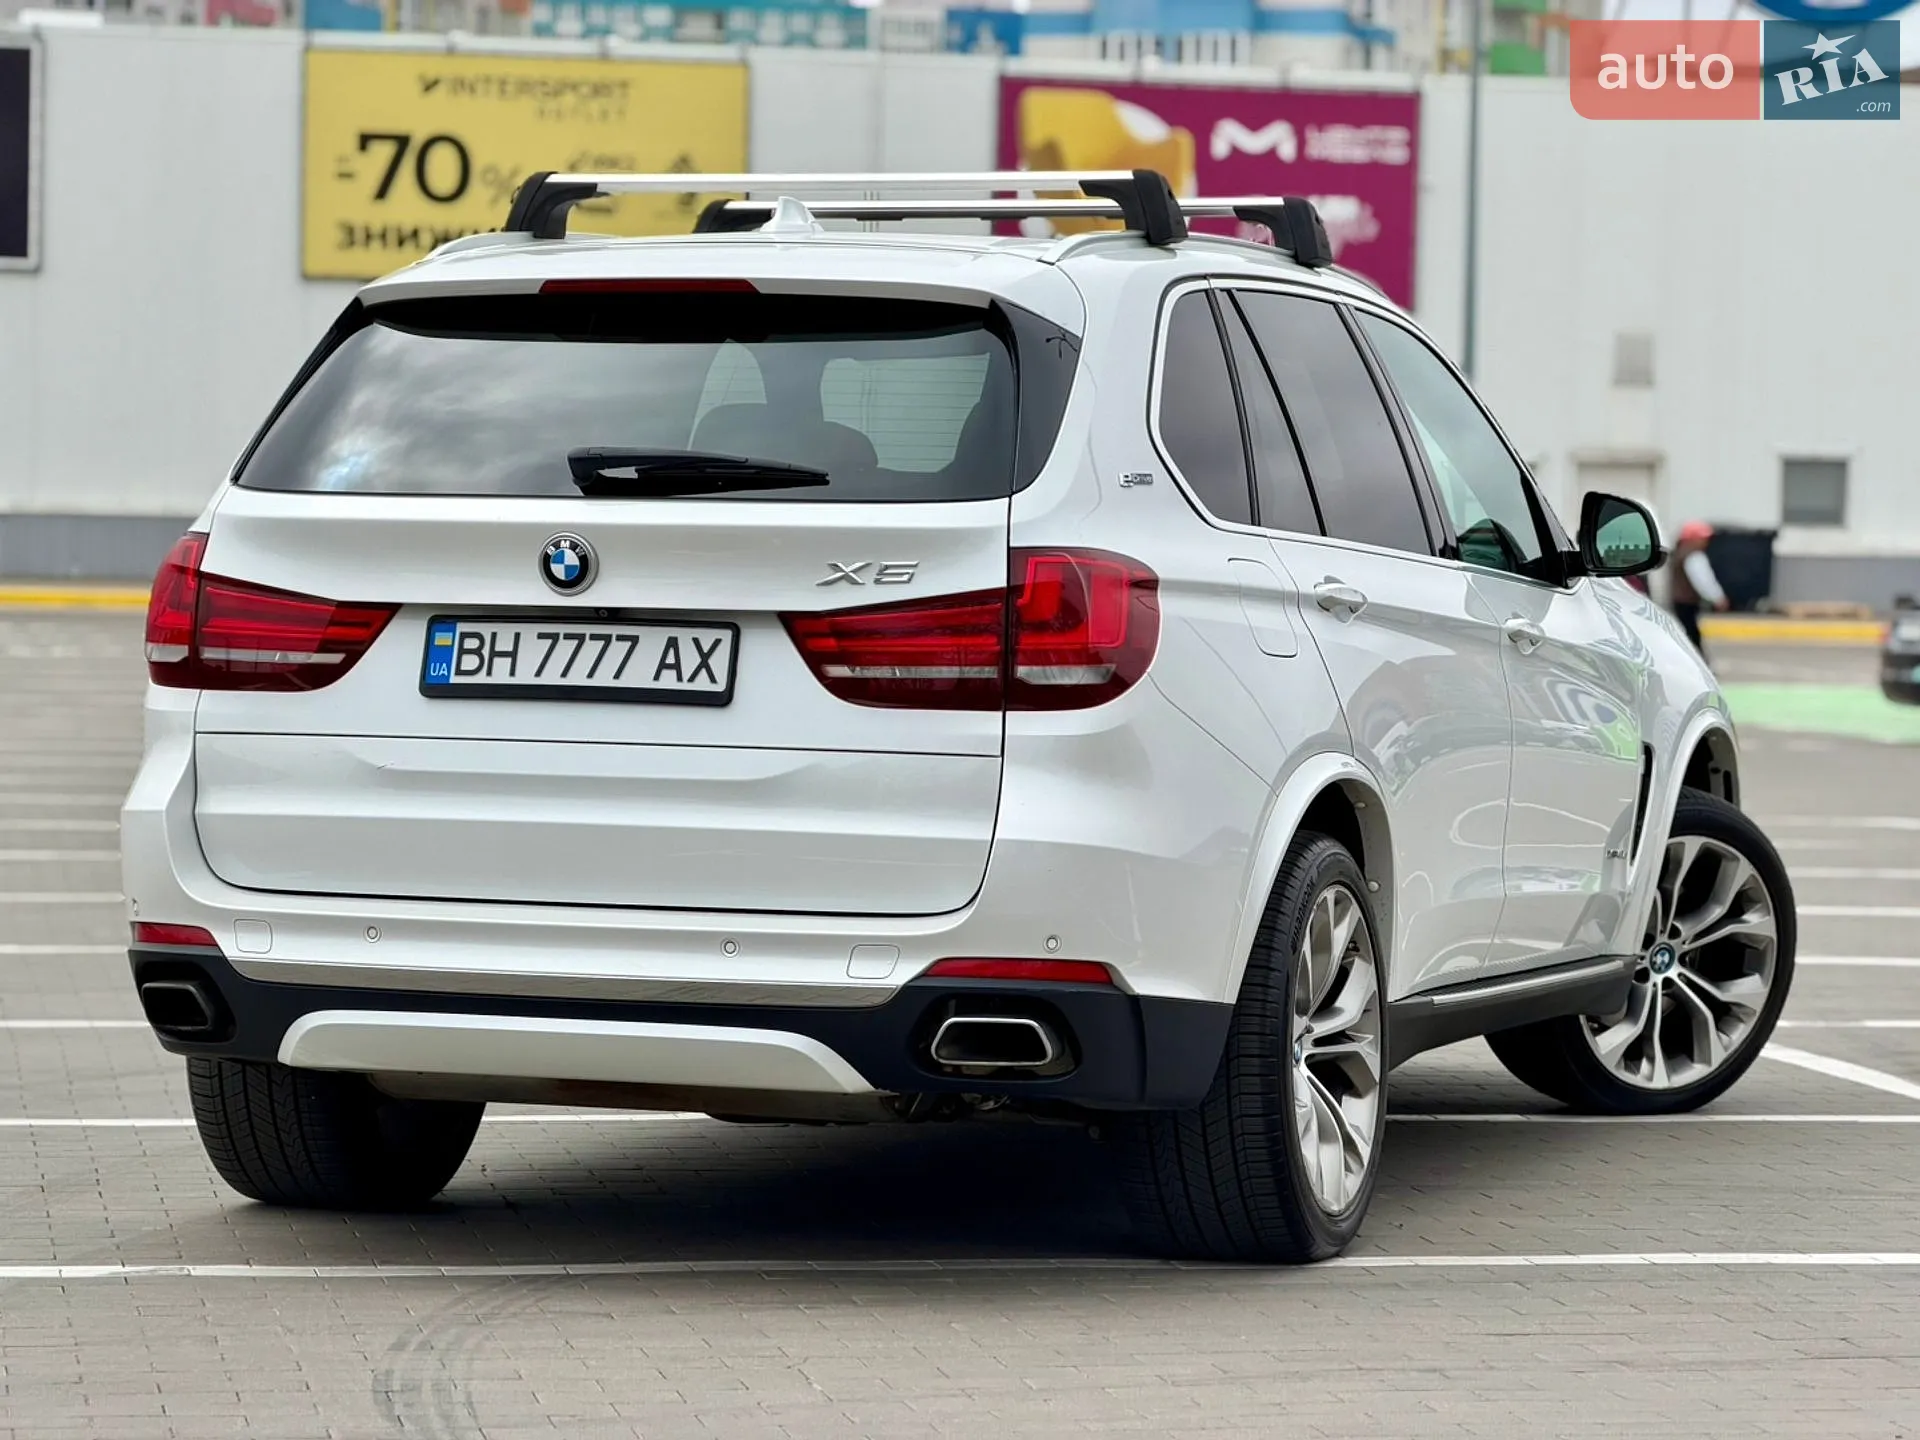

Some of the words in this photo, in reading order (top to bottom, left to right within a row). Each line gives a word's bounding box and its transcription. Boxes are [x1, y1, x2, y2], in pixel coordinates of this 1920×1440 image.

[546, 539, 586, 557] BMW
[815, 560, 920, 587] X5
[454, 631, 521, 677] BH
[534, 632, 640, 680] 7777
[652, 635, 723, 684] AX
[430, 662, 448, 677] UA
